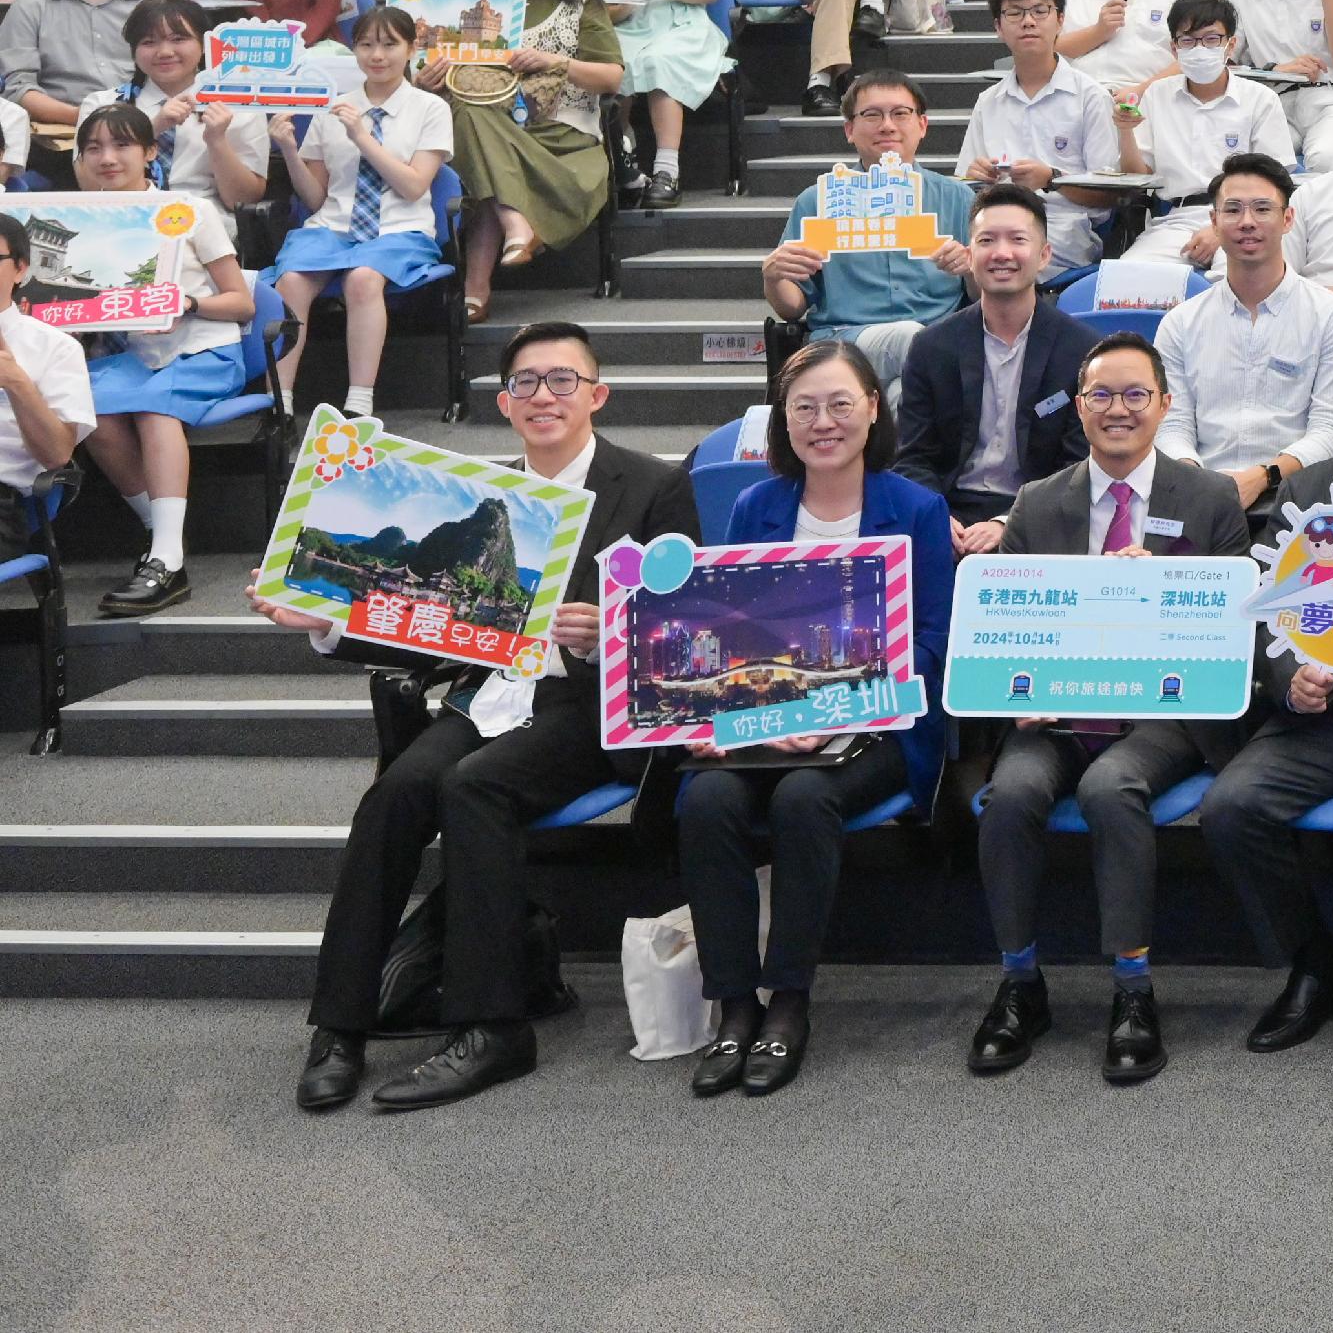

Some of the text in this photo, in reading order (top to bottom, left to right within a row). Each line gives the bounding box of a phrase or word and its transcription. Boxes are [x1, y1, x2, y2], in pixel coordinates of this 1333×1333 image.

[981, 568, 1044, 578] A20241014
[977, 588, 1078, 607] 香港西九龍站
[1100, 586, 1137, 597] G1014
[1160, 590, 1227, 608] 深圳北站
[1177, 633, 1204, 641] Second
[1207, 633, 1226, 641] Class
[1048, 681, 1144, 697] 祝你旅途愉快
